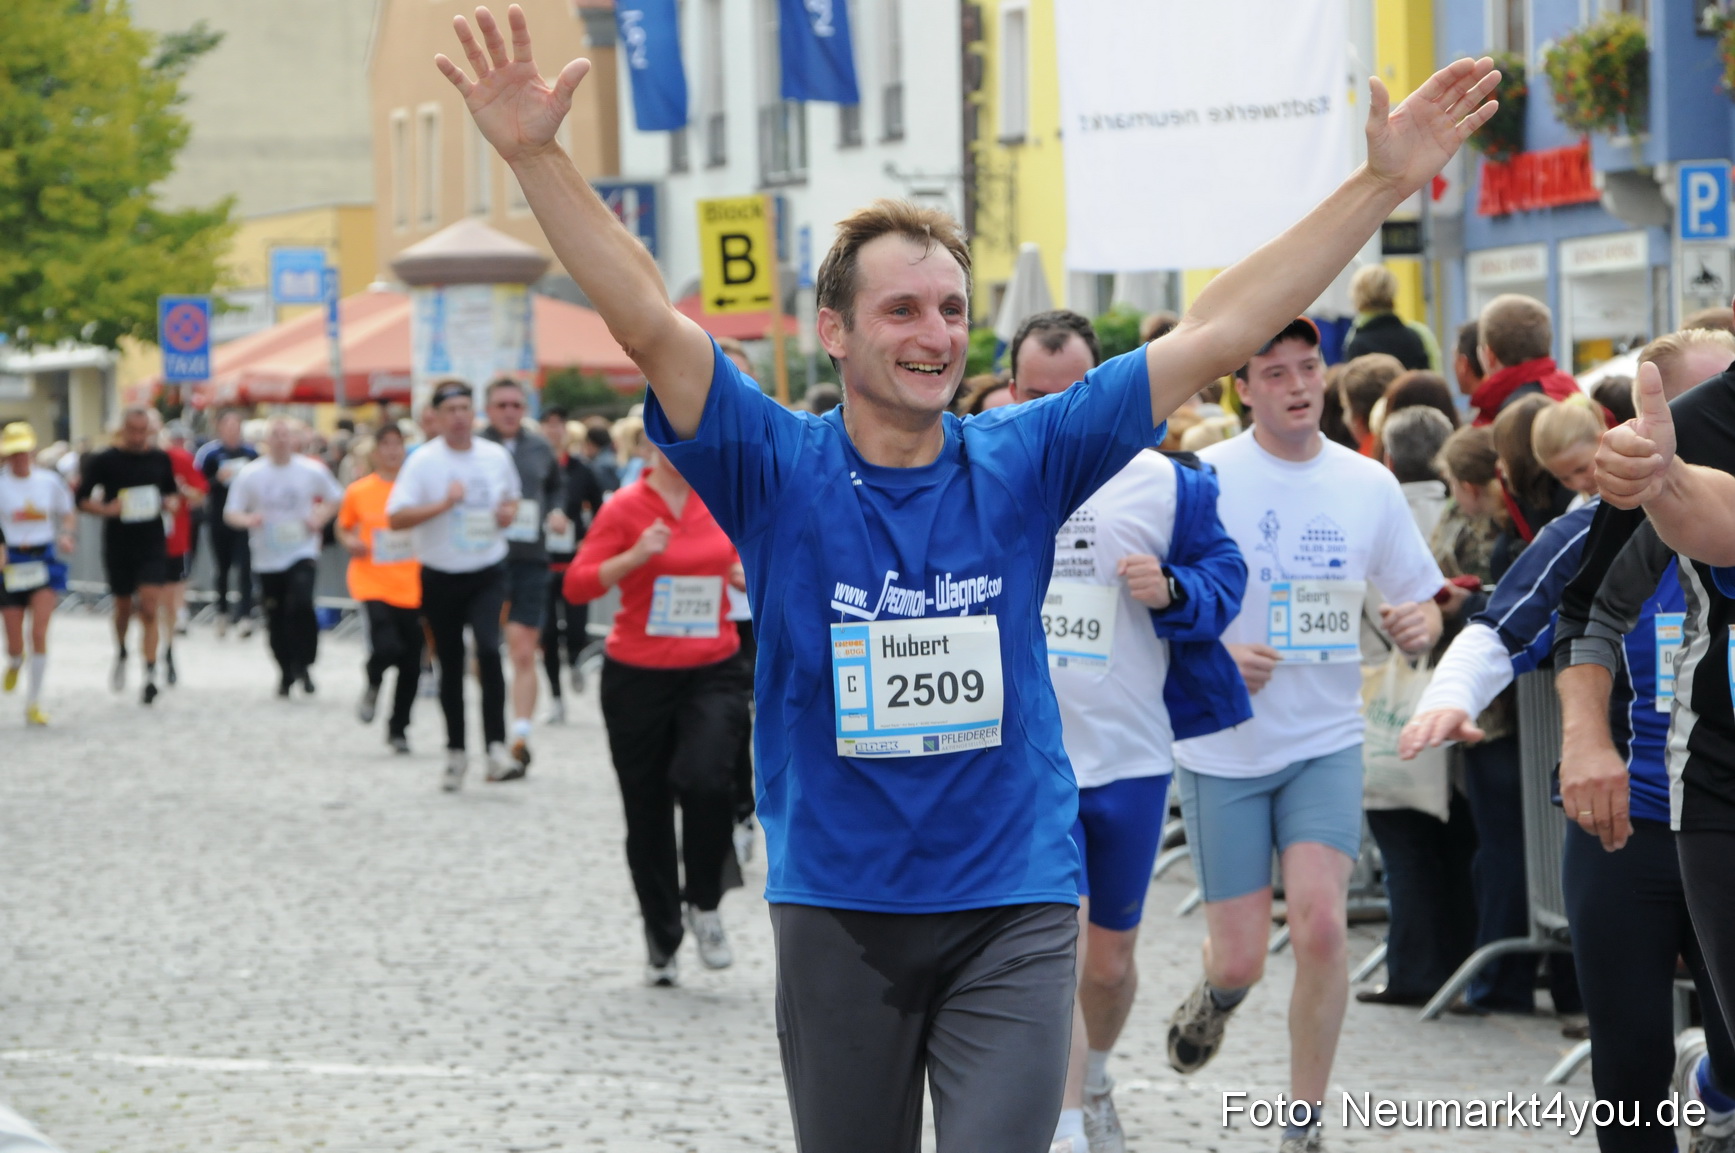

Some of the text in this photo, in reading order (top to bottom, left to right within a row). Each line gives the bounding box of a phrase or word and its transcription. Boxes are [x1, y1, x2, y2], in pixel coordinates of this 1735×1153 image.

[1688, 172, 1719, 233] P
[720, 232, 757, 286] B
[1042, 615, 1101, 641] 3349
[1300, 611, 1349, 633] 3408
[882, 634, 949, 658] Hubert
[1665, 651, 1672, 663] D
[847, 675, 857, 692] C
[887, 669, 984, 708] 2509
[941, 727, 998, 744] PFLEIDERER
